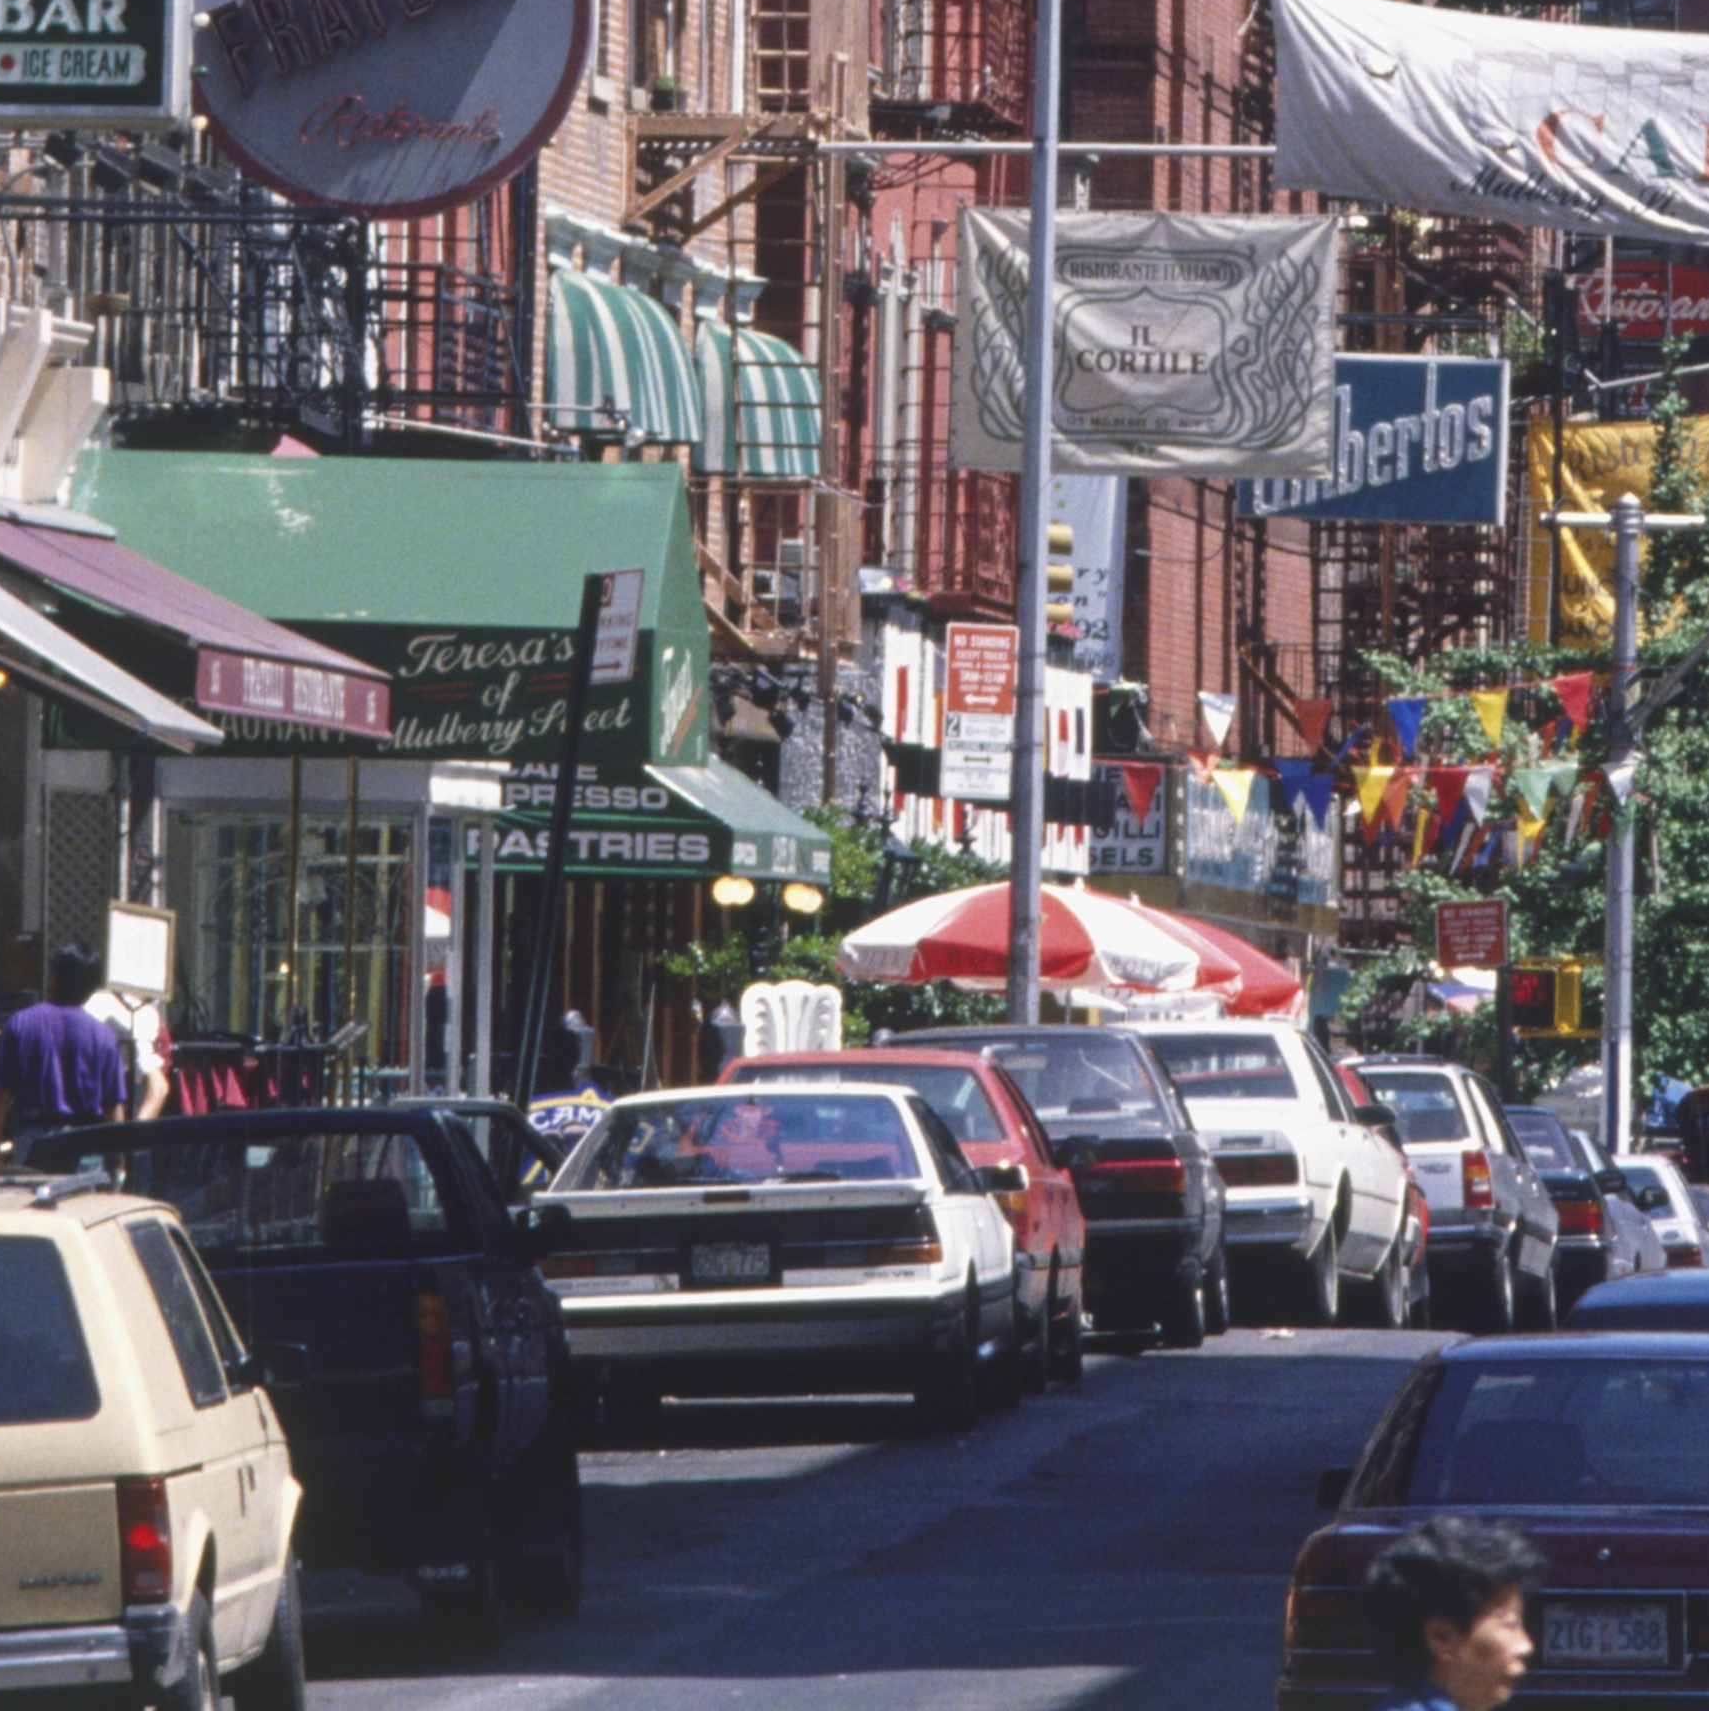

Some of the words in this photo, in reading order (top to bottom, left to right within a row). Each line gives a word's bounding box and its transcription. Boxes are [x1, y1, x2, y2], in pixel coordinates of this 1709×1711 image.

[21, 48, 56, 79] ICE
[60, 48, 132, 79] CREAM
[1451, 167, 1604, 220] Mulberry
[1069, 261, 1160, 283] RISTORANTE
[1162, 262, 1228, 283] ITALIANO
[1129, 324, 1157, 348] IL
[1075, 349, 1210, 376] CORTILE
[399, 631, 576, 679] Teresa's
[953, 634, 967, 648] NO
[970, 634, 1011, 649] STANDING
[481, 670, 521, 717] of
[378, 710, 526, 756] Mulberry
[1548, 1619, 1594, 1651] ZTG
[1616, 1617, 1661, 1651] 588
